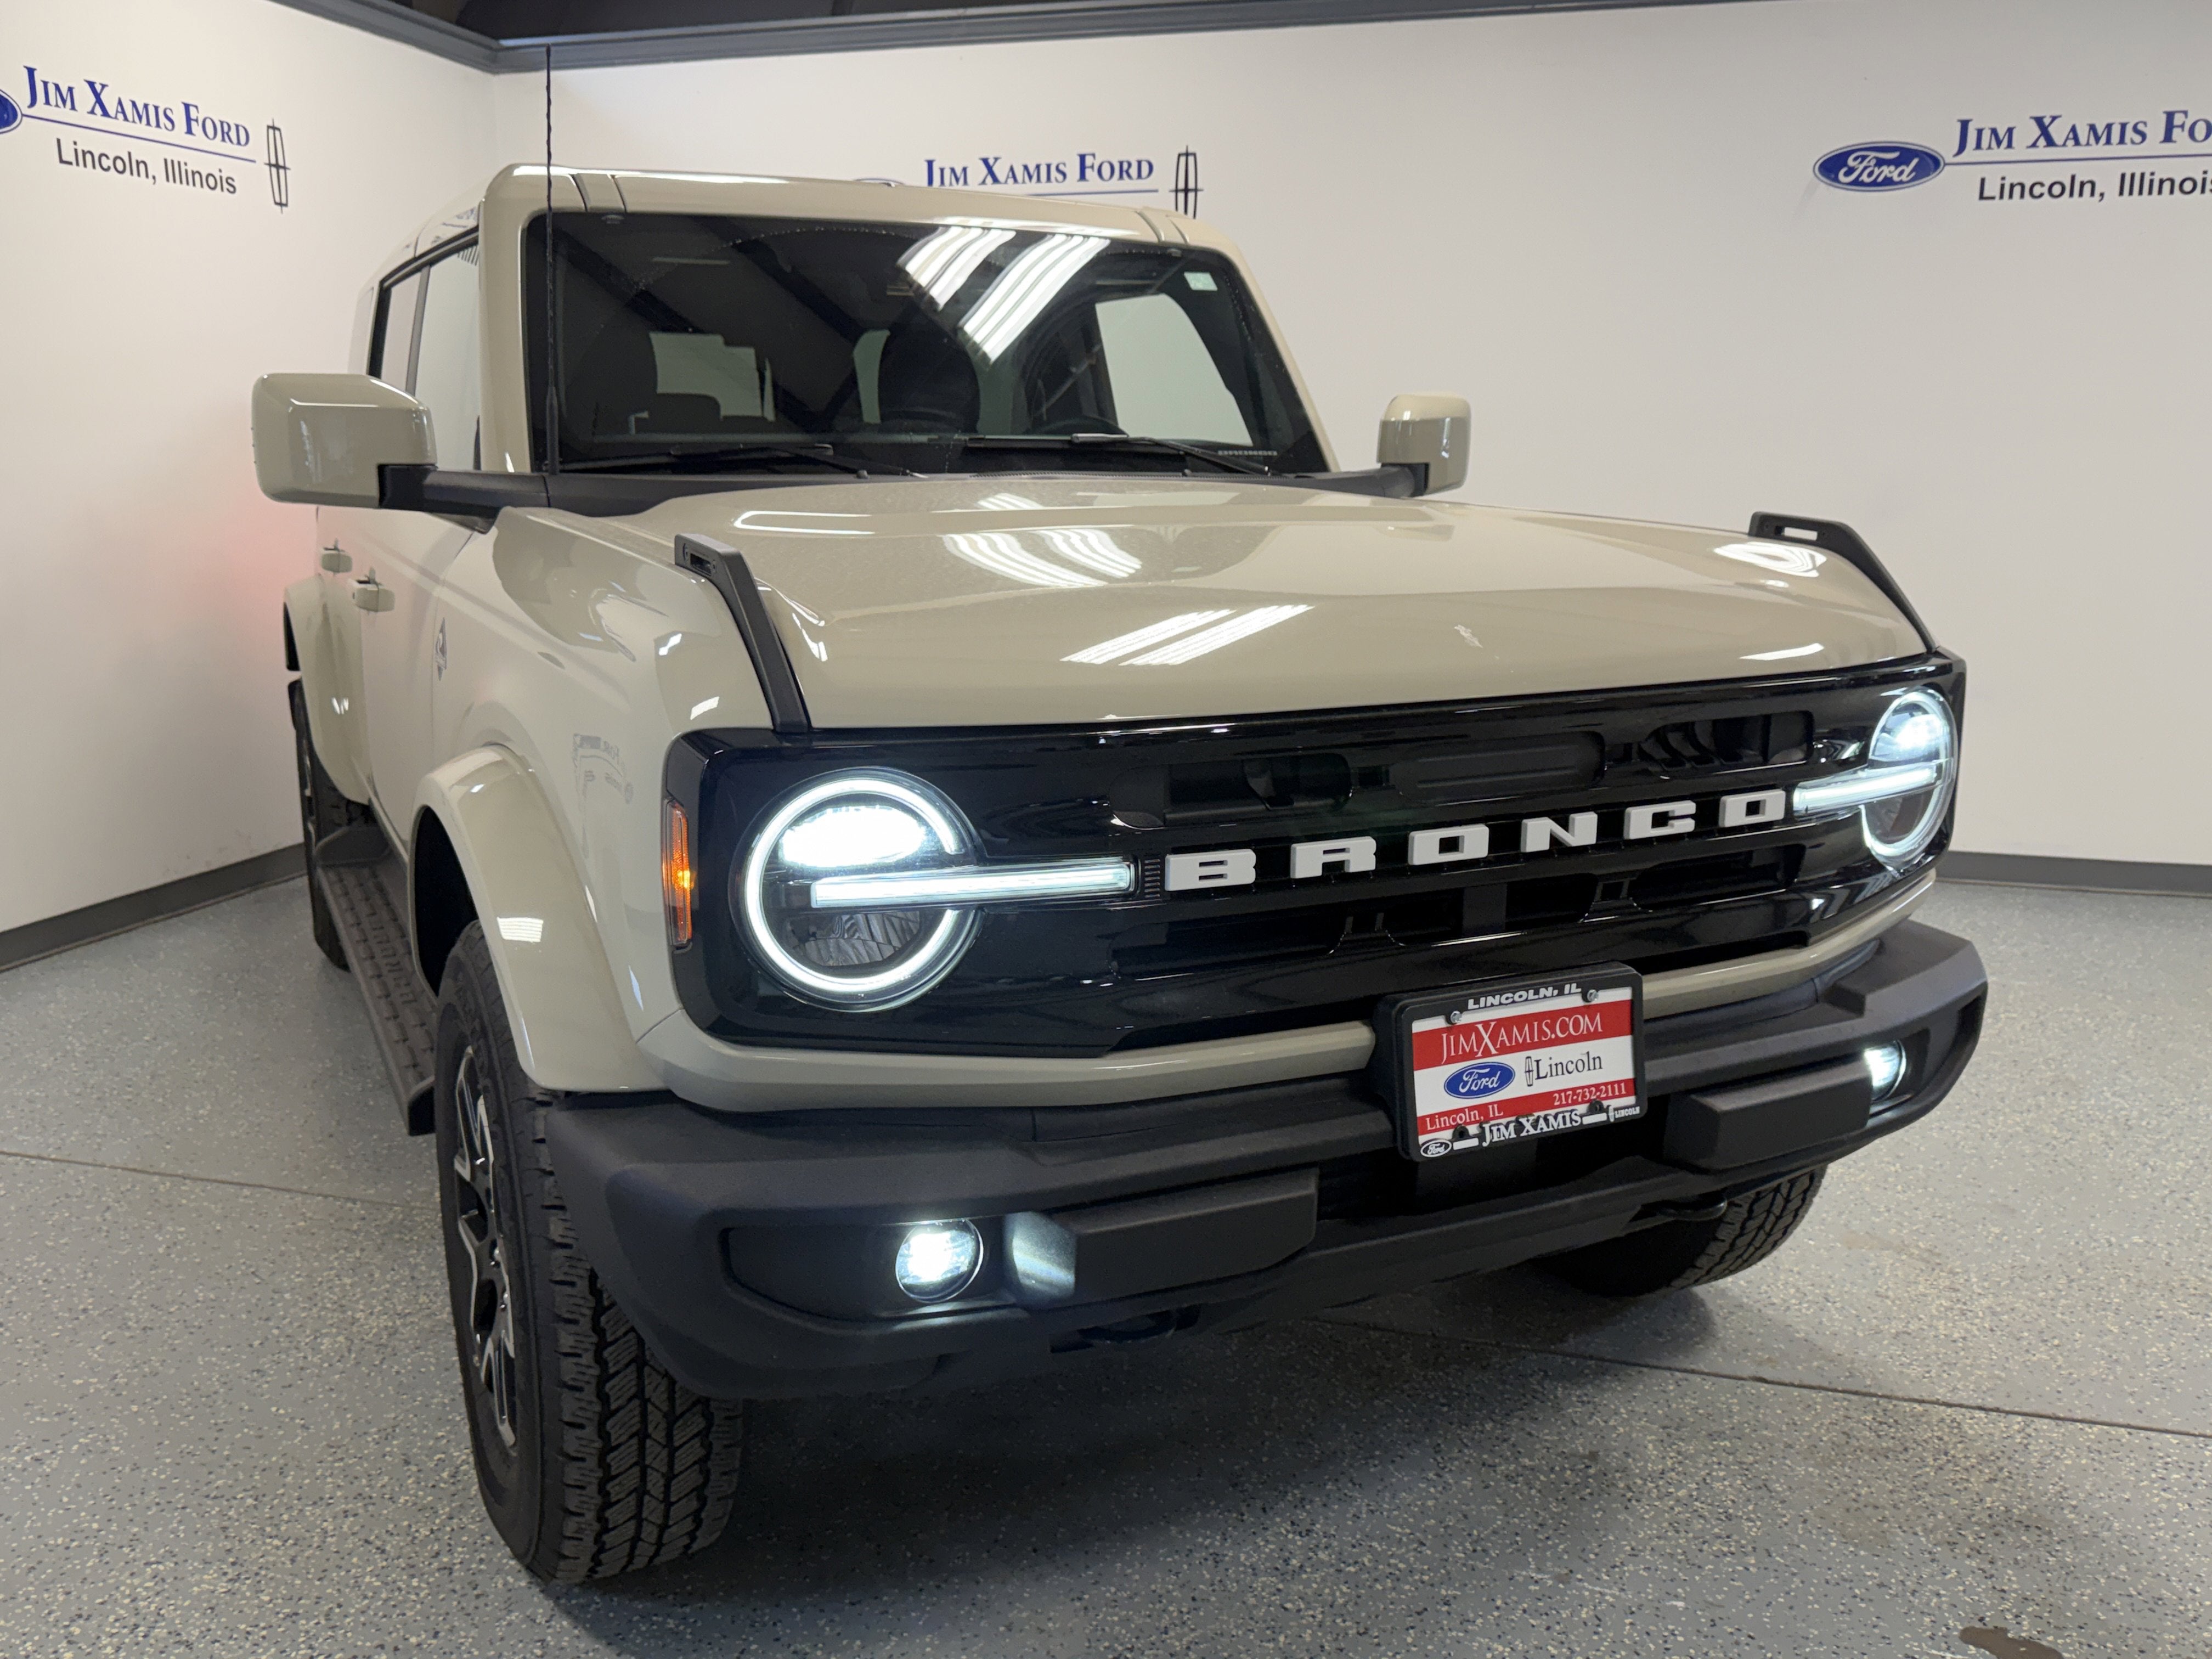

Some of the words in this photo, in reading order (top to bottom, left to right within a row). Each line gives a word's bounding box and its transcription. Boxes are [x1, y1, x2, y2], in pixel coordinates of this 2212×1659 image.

[24, 66, 78, 111] JIM
[83, 79, 176, 131] XAMIS
[181, 101, 250, 147] FORD
[1953, 119, 2016, 157] JIM
[2026, 114, 2148, 149] XAMIS
[56, 138, 156, 185] Lincoln,
[164, 158, 237, 194] Illinois
[924, 159, 969, 187] JIM
[978, 156, 1067, 185] XAMIS
[1076, 153, 1154, 182] FORD
[1838, 151, 1919, 183] Ford
[1978, 173, 2106, 202] Lincoln,
[2118, 170, 2212, 197] Illinoi
[1164, 789, 1786, 892] BRONCO
[1468, 986, 1559, 1010] LINCOLN,
[1564, 983, 1582, 995] IL
[1441, 1012, 1603, 1065] JIMXAMIS.COM
[1459, 1068, 1501, 1093] Ford
[1534, 1051, 1603, 1080] Lincoln
[1553, 1082, 1627, 1105] 217-732-2111
[1425, 1108, 1483, 1131] Lincoln,
[1488, 1104, 1504, 1118] IL
[1482, 1122, 1516, 1147] JIM
[1519, 1110, 1582, 1136] XAMIS
[1615, 1105, 1640, 1119] LINCOLN
[1427, 1143, 1445, 1155] Ford
